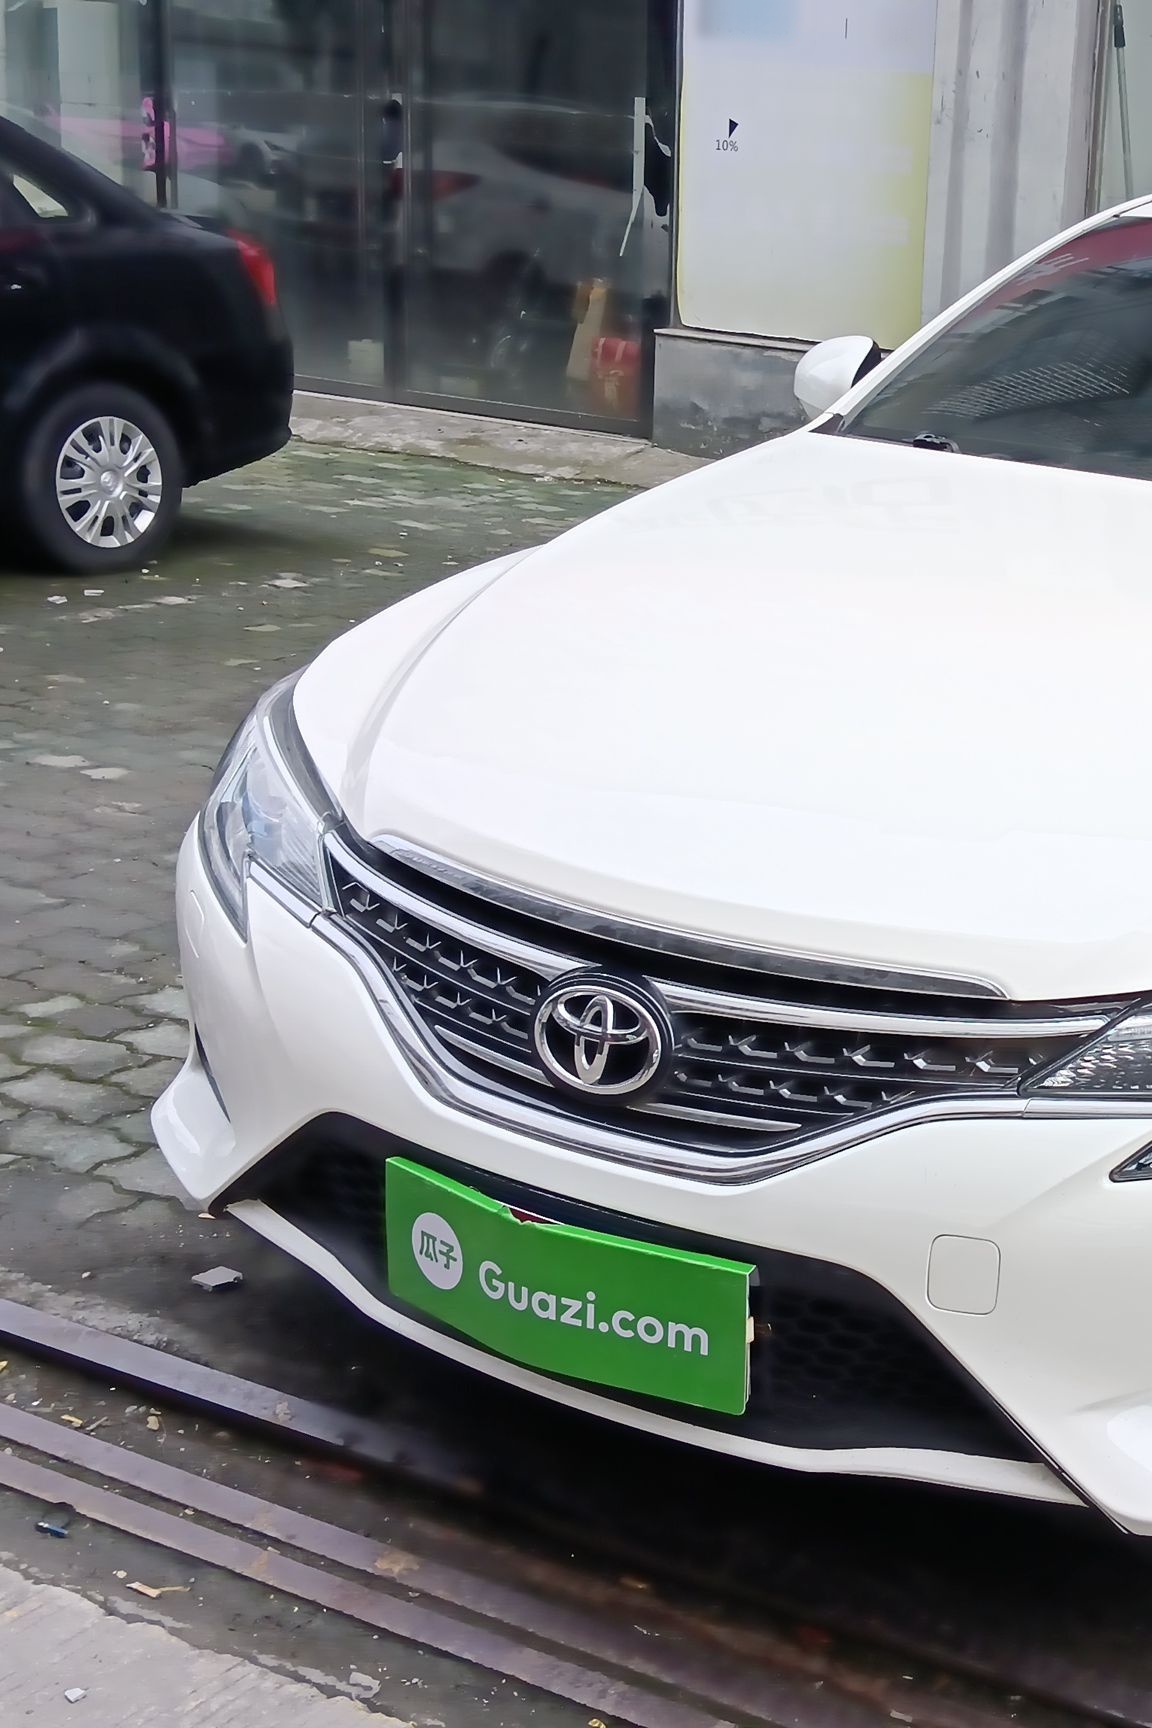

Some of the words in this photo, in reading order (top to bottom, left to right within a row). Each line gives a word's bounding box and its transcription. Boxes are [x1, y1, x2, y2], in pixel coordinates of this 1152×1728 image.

[715, 139, 739, 152] 10%
[419, 1230, 458, 1270] 瓜子
[479, 1260, 709, 1356] Guazi.com
